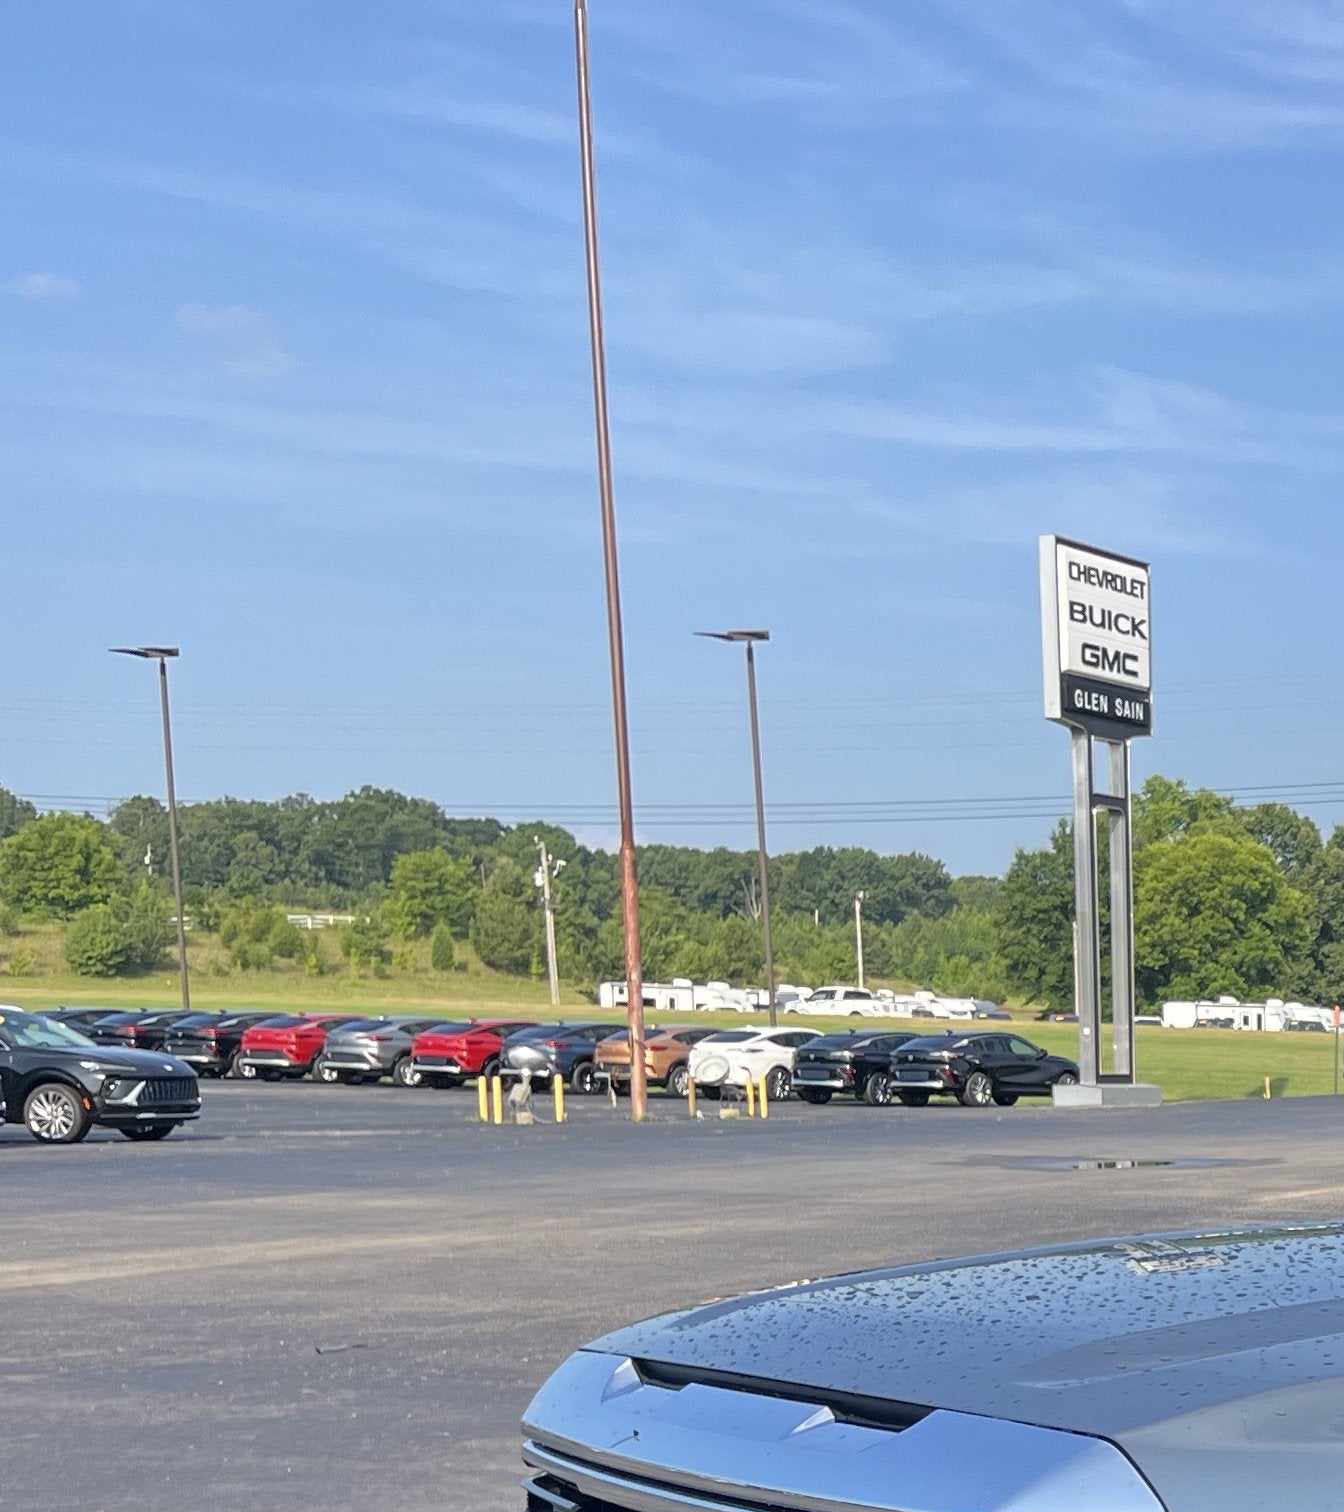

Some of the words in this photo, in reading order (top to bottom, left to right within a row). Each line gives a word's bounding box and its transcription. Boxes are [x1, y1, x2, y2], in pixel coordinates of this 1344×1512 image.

[1068, 561, 1146, 600] CHEVROLET
[1068, 600, 1148, 640] BUICK
[1081, 642, 1139, 678] GMC
[1073, 689, 1109, 714] GLEN
[1115, 696, 1145, 721] SAIN
